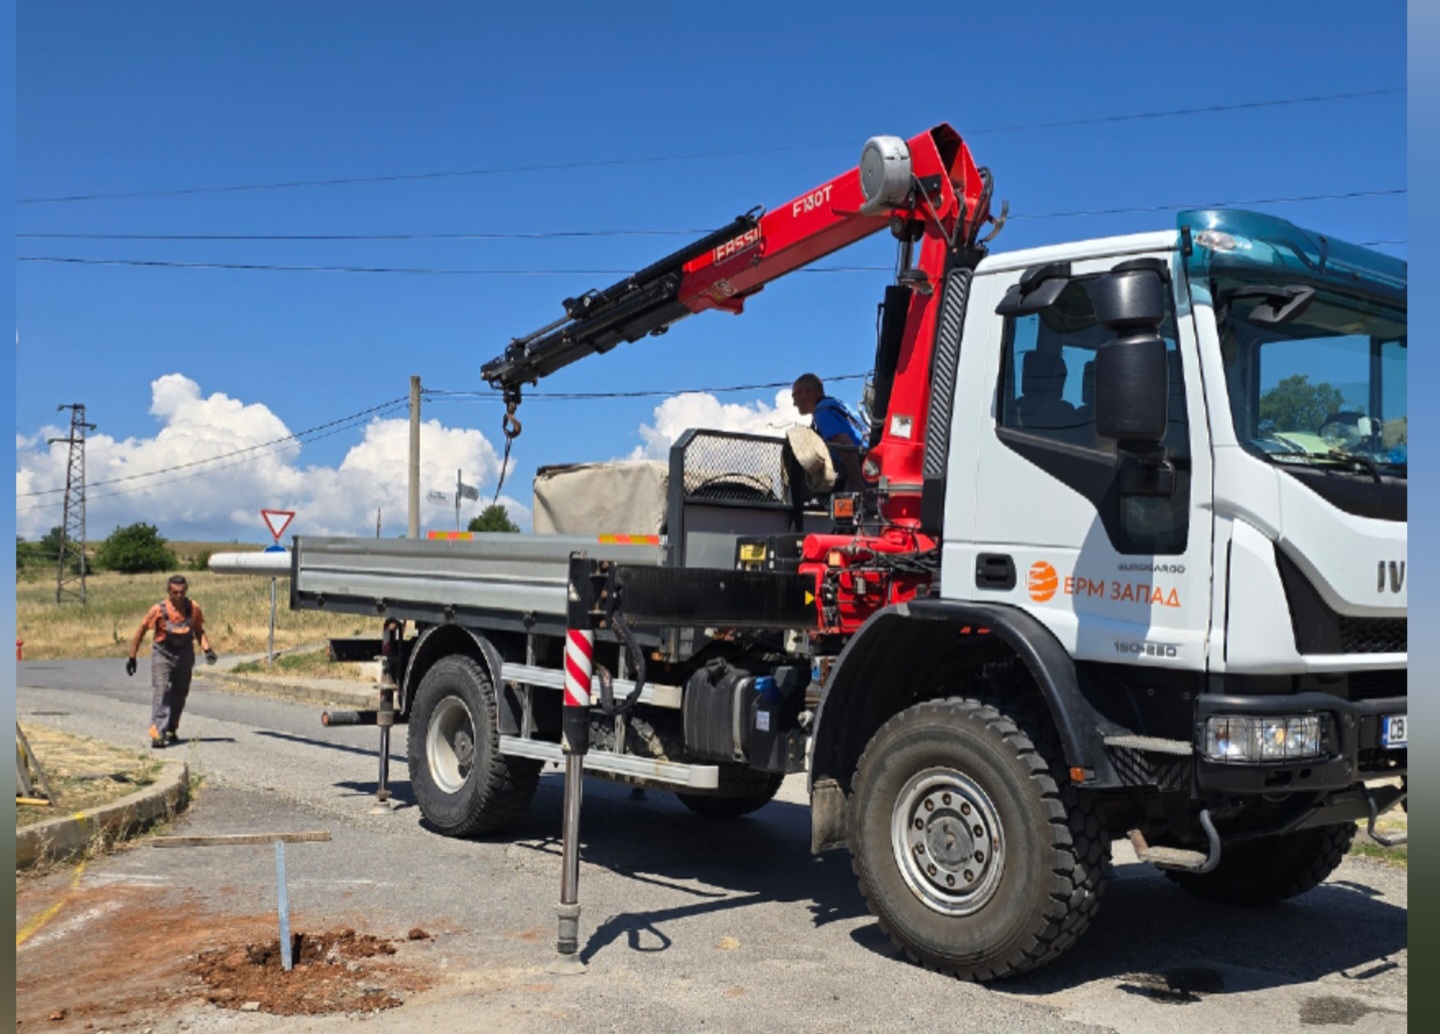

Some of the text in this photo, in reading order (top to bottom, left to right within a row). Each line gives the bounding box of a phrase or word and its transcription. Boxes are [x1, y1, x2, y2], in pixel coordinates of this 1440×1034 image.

[715, 227, 759, 261] FASSI
[1063, 576, 1181, 607] ЕРМ ЗАПАД
